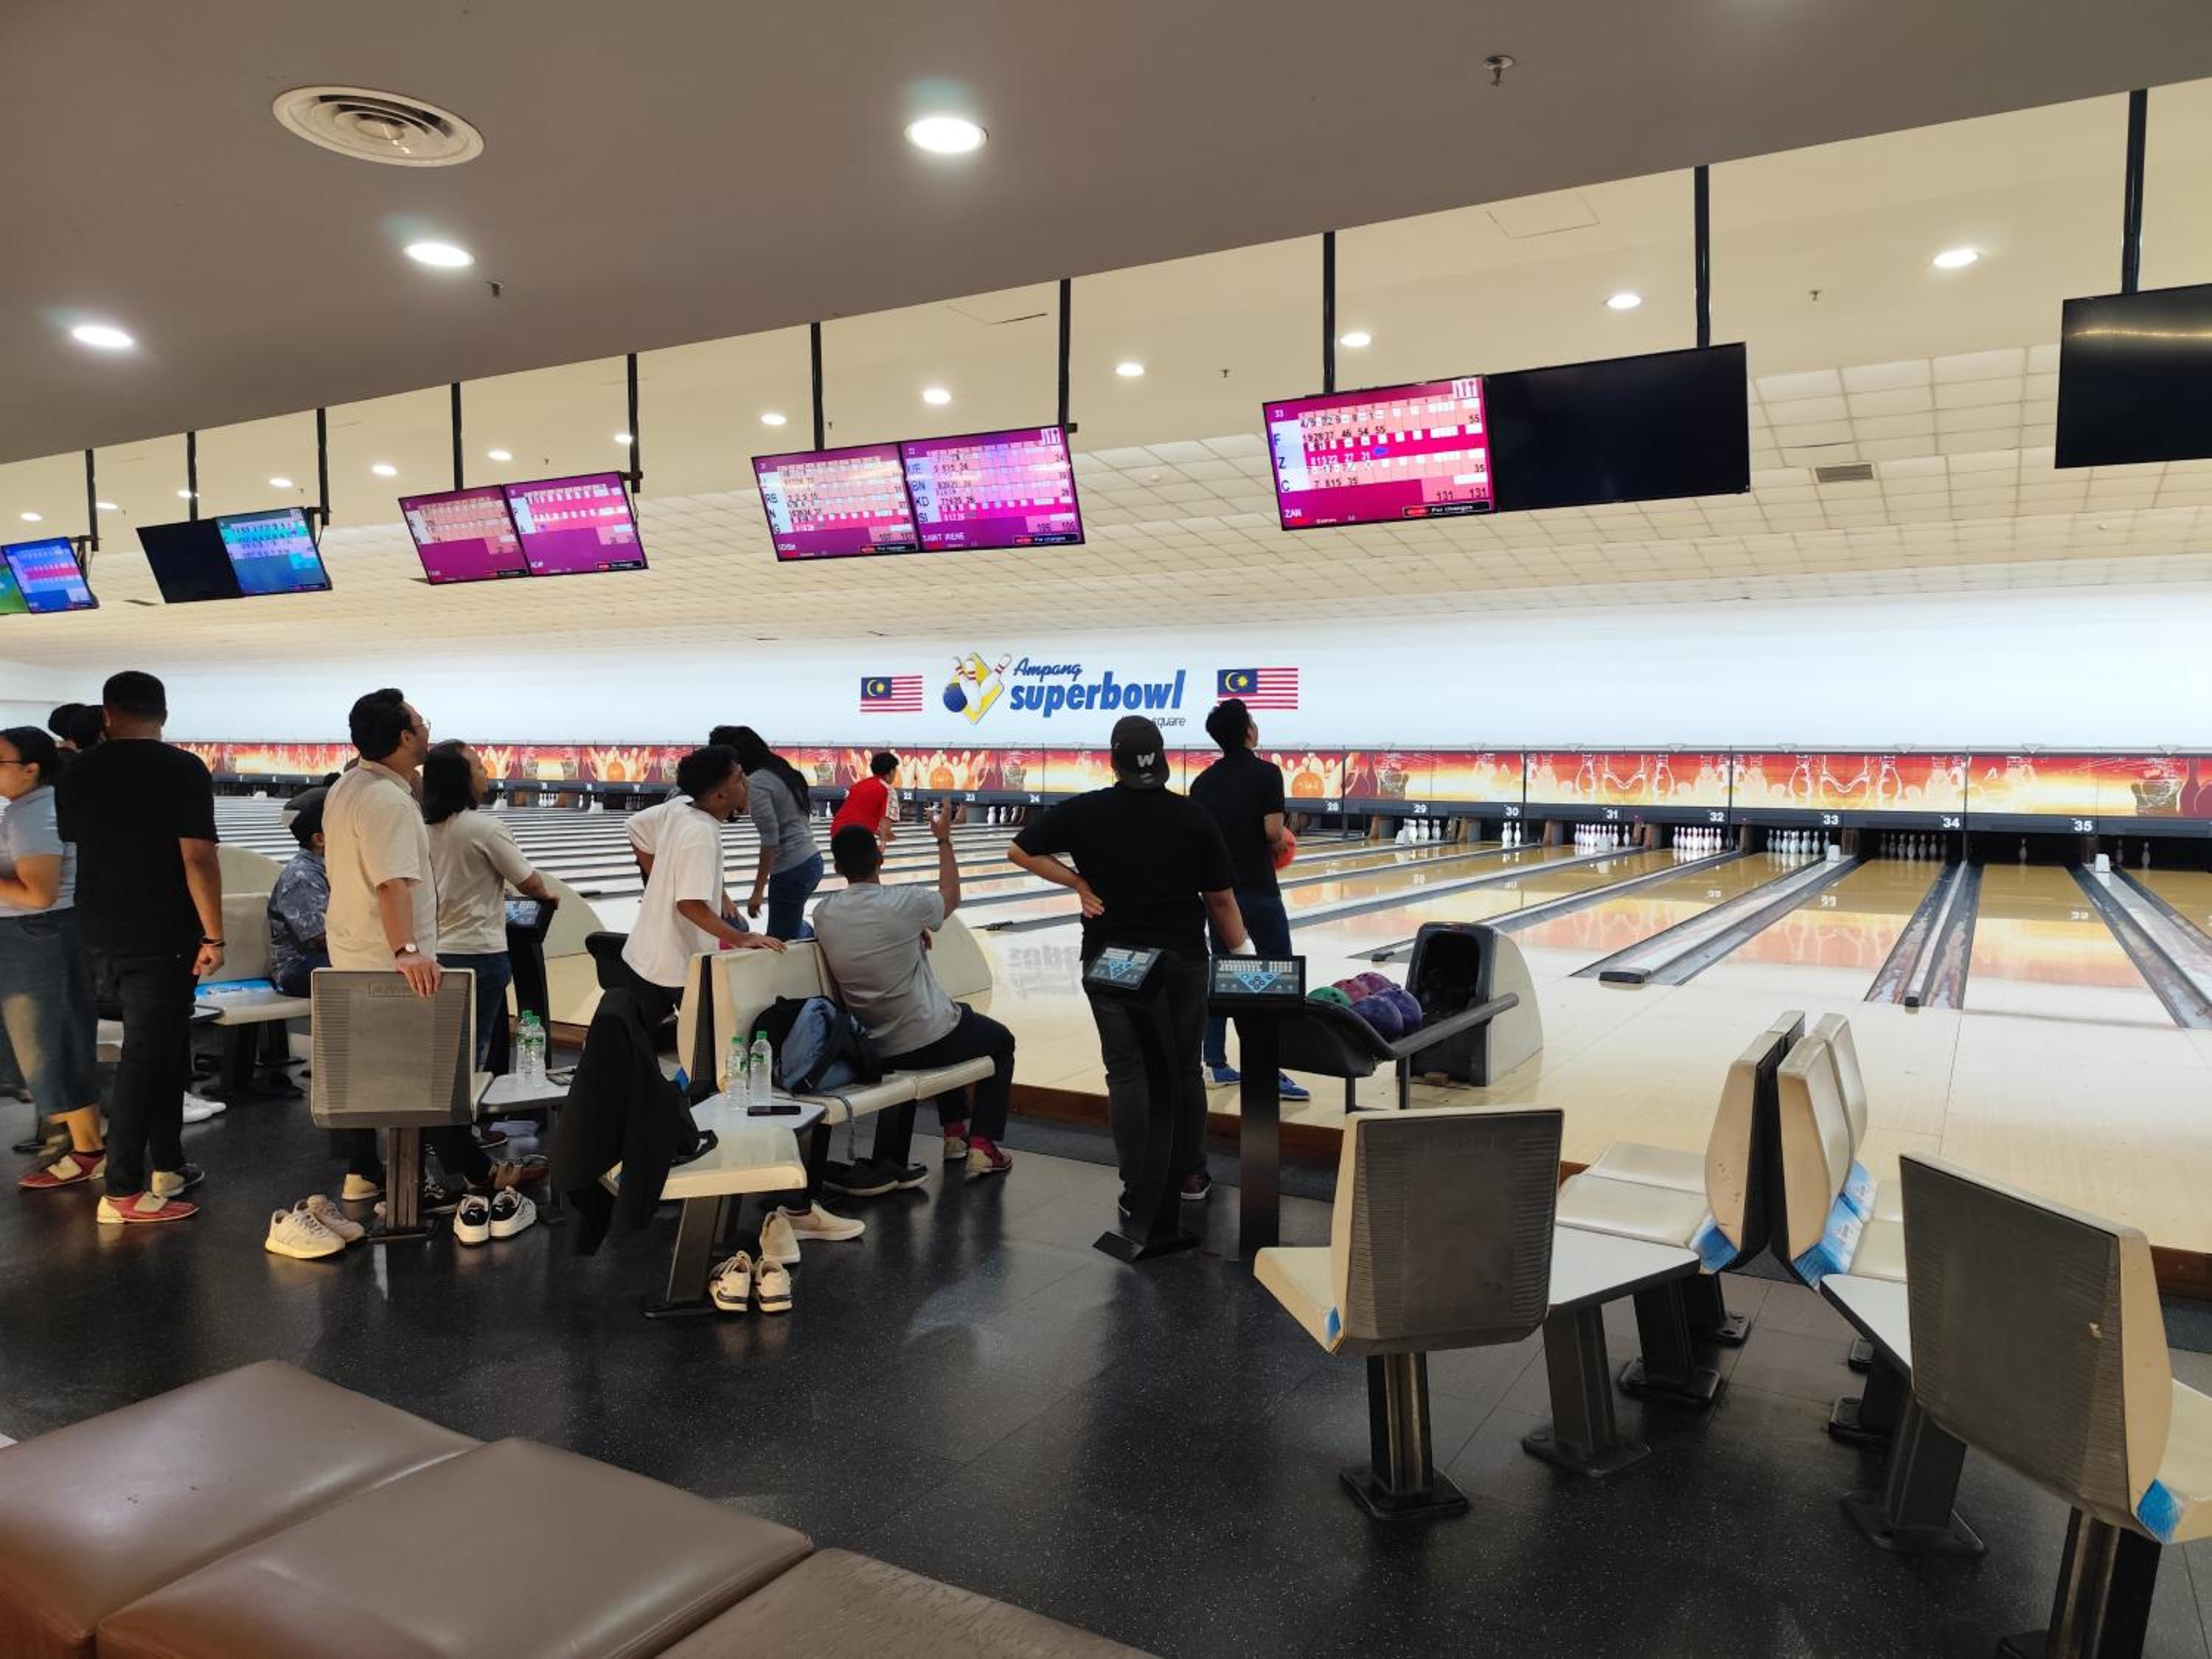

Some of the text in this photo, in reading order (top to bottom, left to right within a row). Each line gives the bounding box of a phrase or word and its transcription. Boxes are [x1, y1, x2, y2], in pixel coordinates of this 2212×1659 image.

[1469, 414, 1480, 423] 55
[1357, 428, 1368, 436] 54
[1376, 426, 1385, 434] 55
[1278, 456, 1286, 469] Z
[1474, 464, 1485, 473] 35
[1012, 657, 1083, 682] Ampang
[1009, 669, 1186, 717] superbowl
[1136, 752, 1155, 768] W
[1413, 804, 1427, 814] 29
[1506, 807, 1520, 816] 30
[1606, 809, 1618, 819] 31
[1710, 812, 1725, 822] 32
[1823, 814, 1839, 825] 33
[1942, 816, 1961, 829] 34
[2074, 819, 2093, 832] 35
